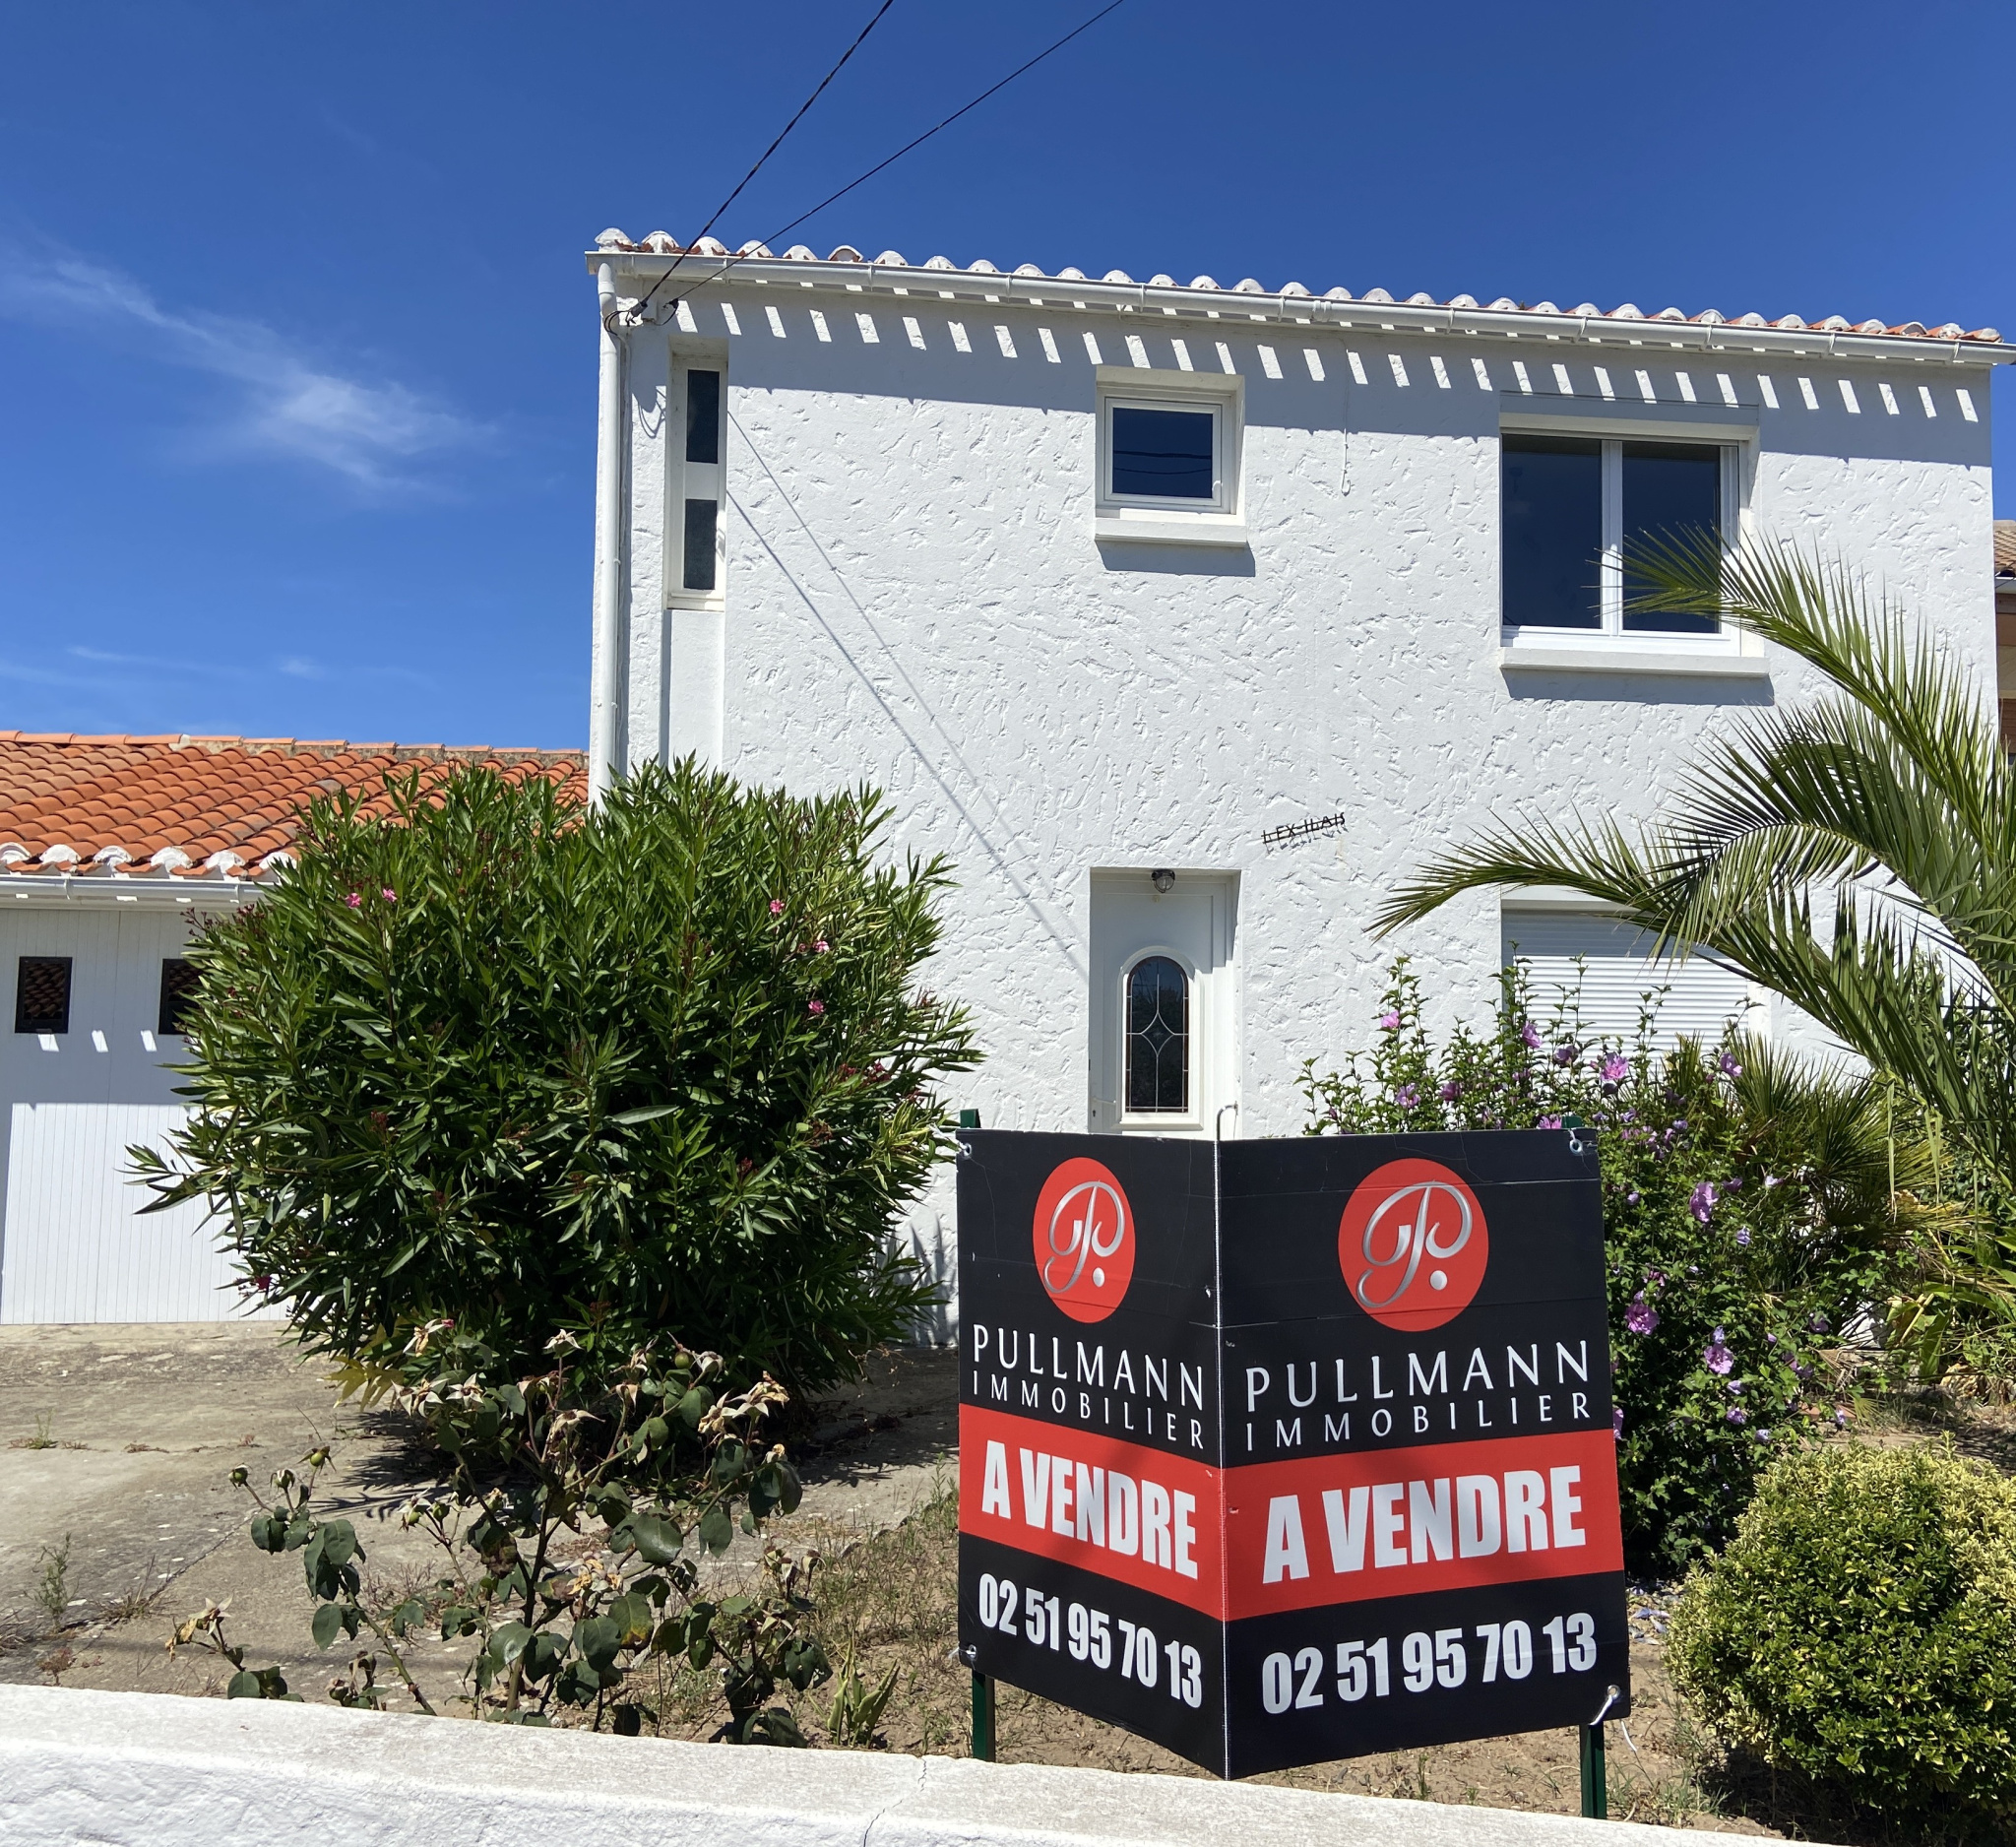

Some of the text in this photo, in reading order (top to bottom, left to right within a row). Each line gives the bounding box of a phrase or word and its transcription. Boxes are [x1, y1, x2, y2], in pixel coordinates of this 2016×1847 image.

[972, 1323, 1204, 1412] PULLMANN
[973, 1369, 1205, 1450] IMMOBILIER
[1245, 1339, 1589, 1413] PULLMANN
[1246, 1392, 1591, 1452] IMMOBILIER
[981, 1439, 1198, 1580] A VENDRE
[1262, 1465, 1586, 1584] A VENDRE
[978, 1572, 1202, 1708] 02 51 95 70 13
[1262, 1612, 1597, 1715] 02 51 95 70 13
